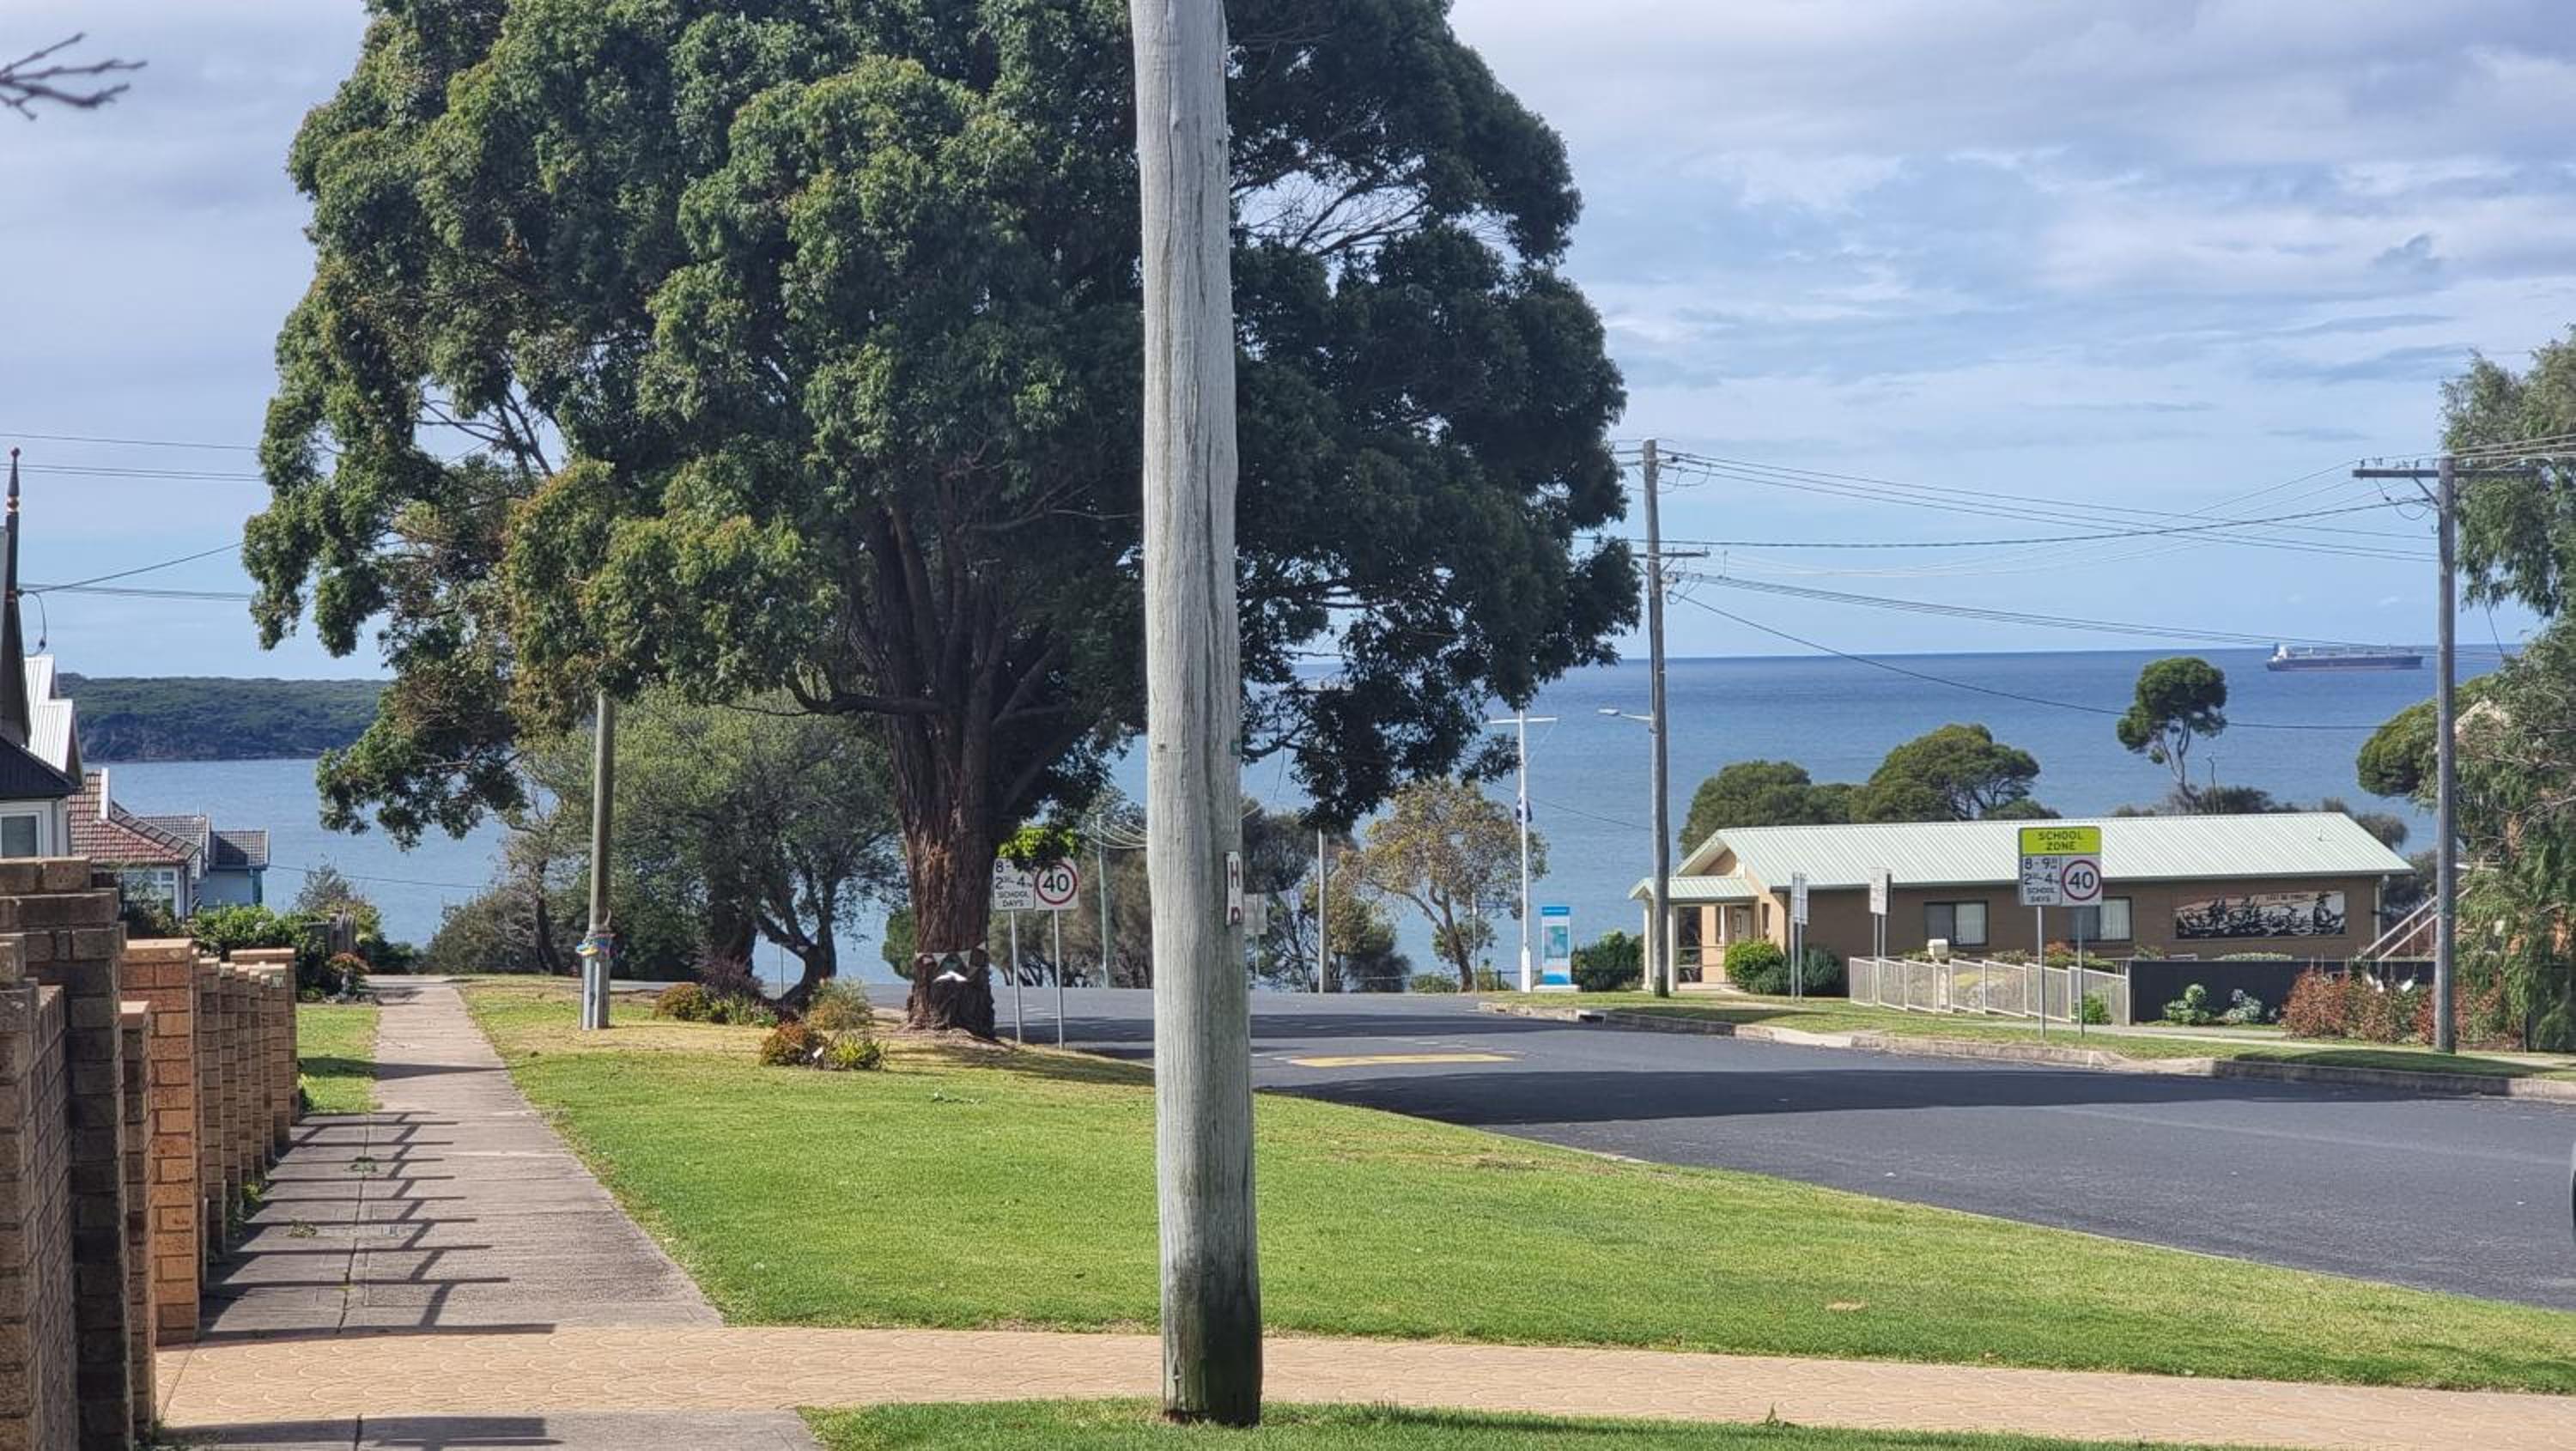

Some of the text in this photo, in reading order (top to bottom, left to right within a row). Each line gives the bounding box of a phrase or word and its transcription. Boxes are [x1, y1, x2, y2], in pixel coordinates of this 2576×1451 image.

[2038, 831, 2083, 841] SCHOOL
[2046, 841, 2075, 851] ZONE
[1042, 873, 1070, 893] 40
[2068, 871, 2094, 889] 40
[996, 890, 1030, 899] SCHOOL
[1002, 899, 1024, 908] DAYS
